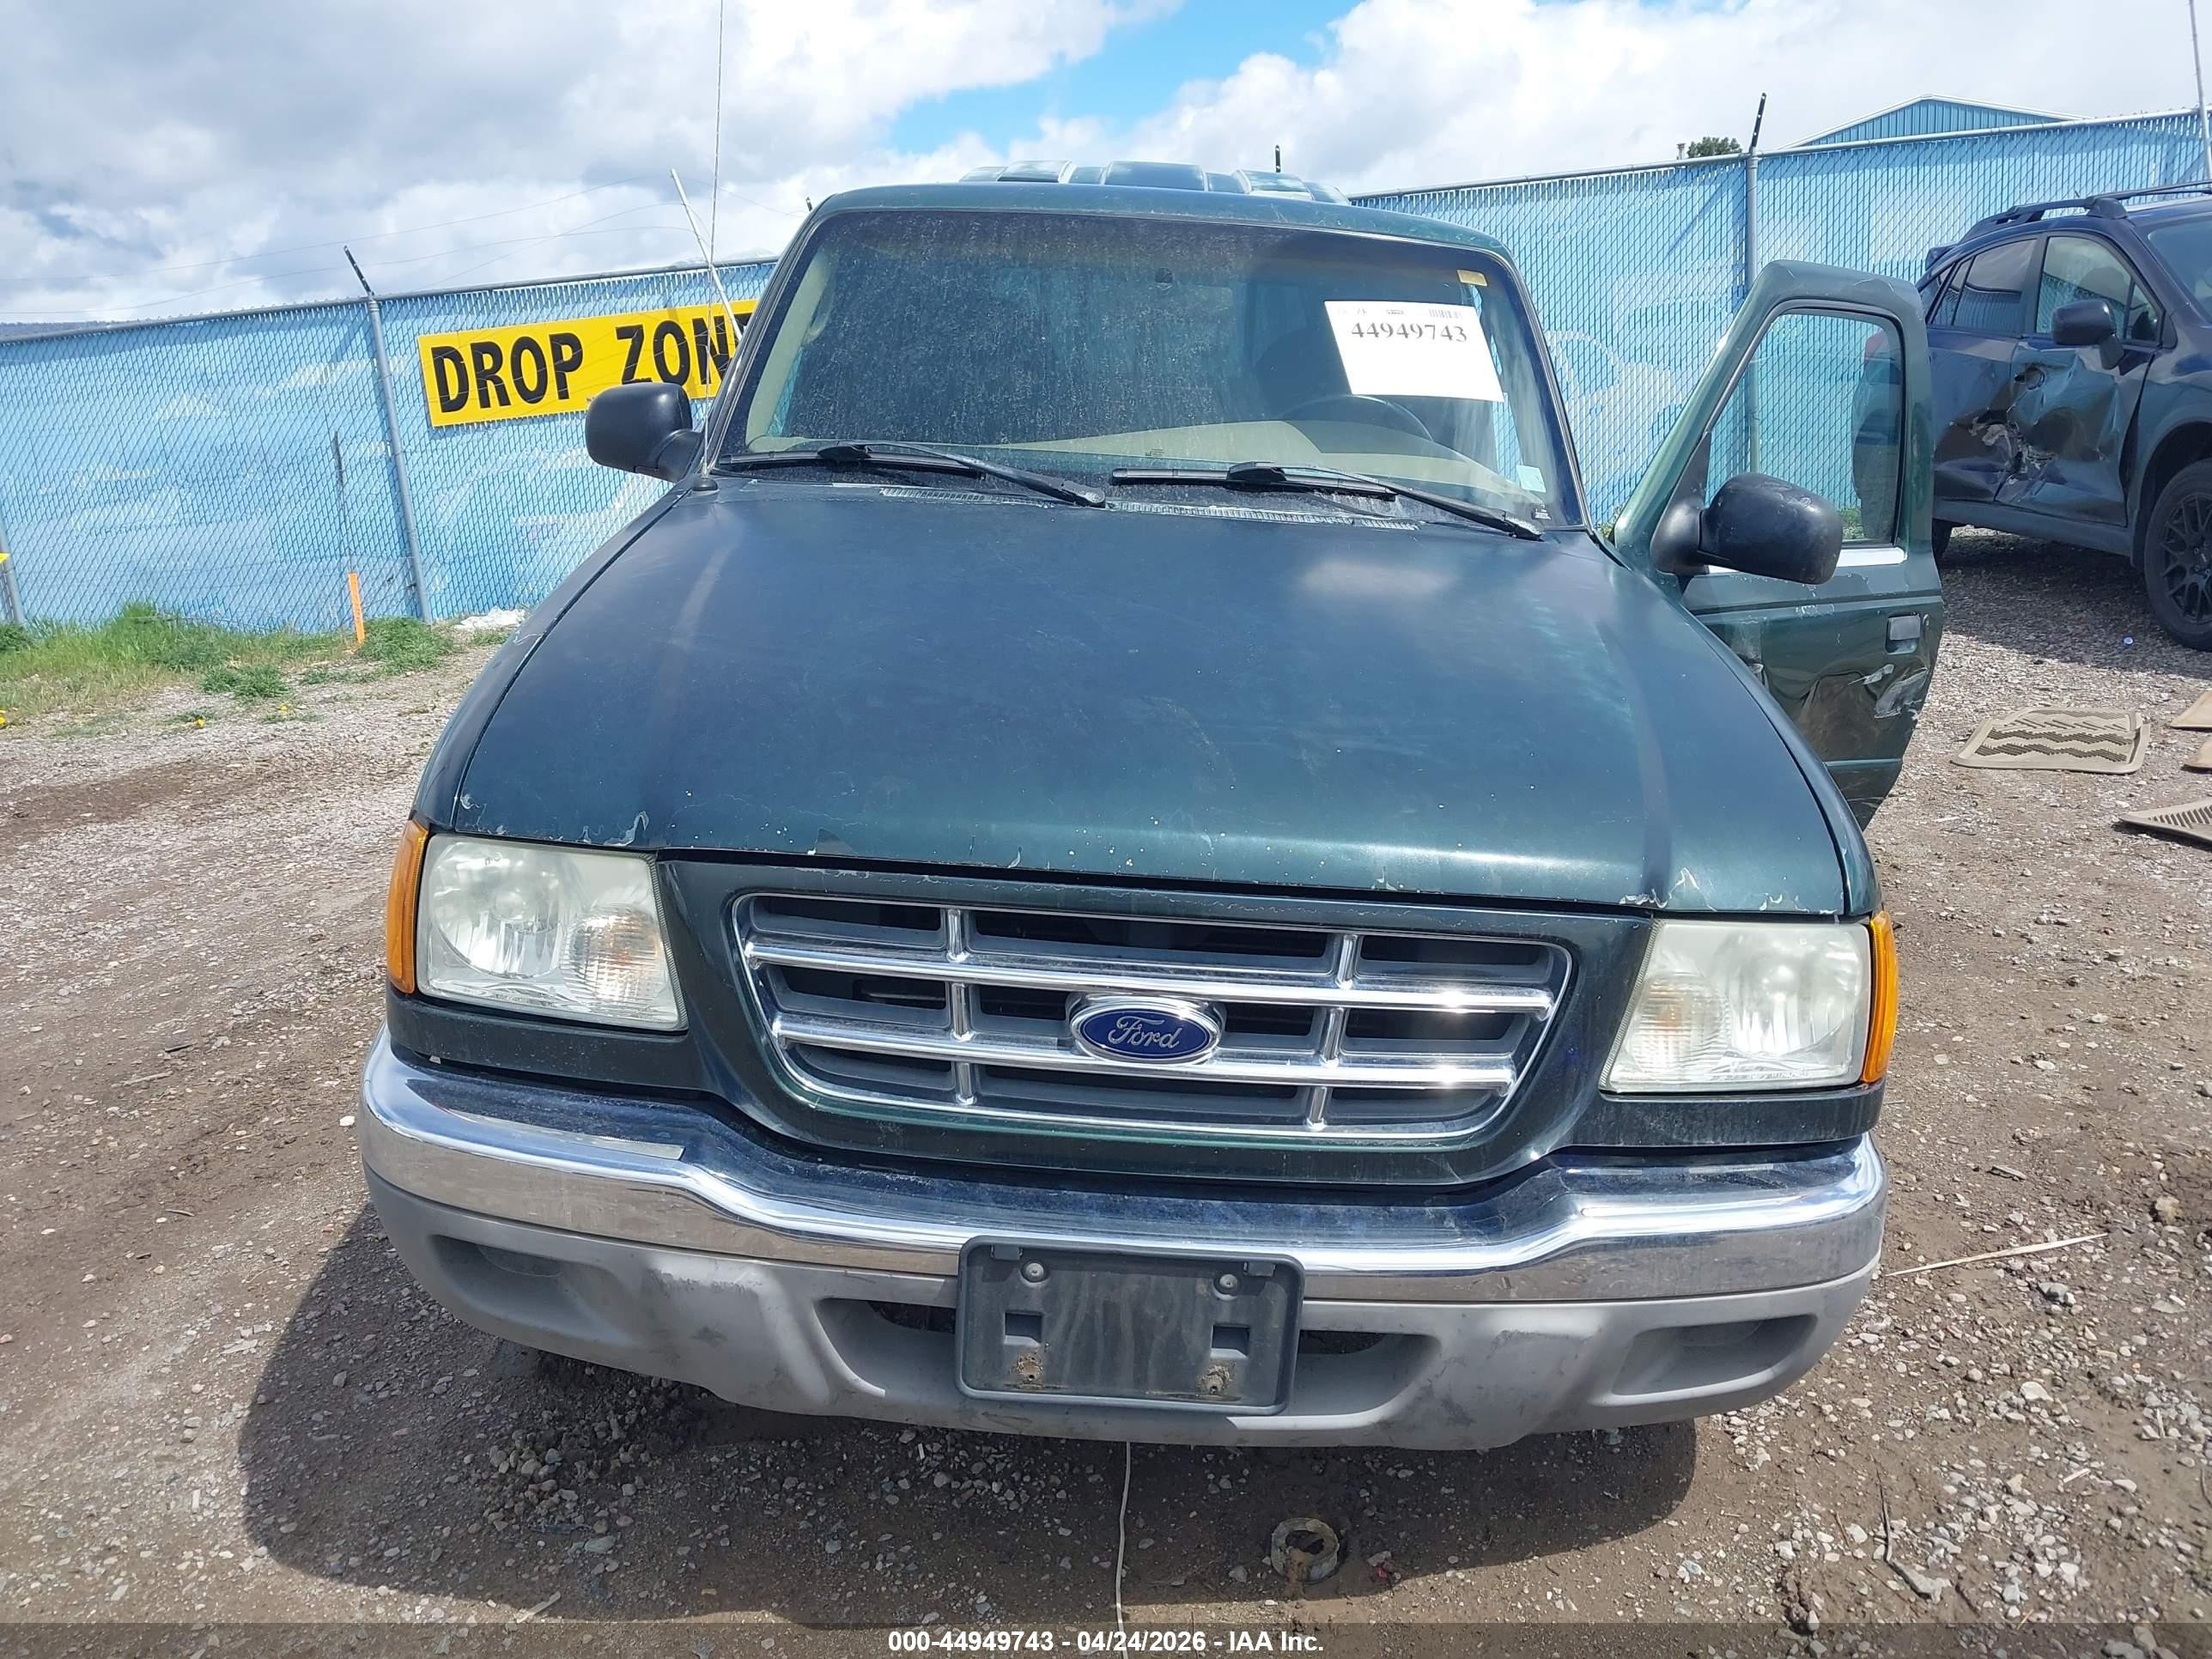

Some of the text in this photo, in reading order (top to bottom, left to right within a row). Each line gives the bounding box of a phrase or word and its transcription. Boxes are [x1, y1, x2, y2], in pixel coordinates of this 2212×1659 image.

[1352, 322, 1468, 343] 44949743
[431, 313, 752, 413] DROP ZON
[1108, 1016, 1182, 1048] Ford
